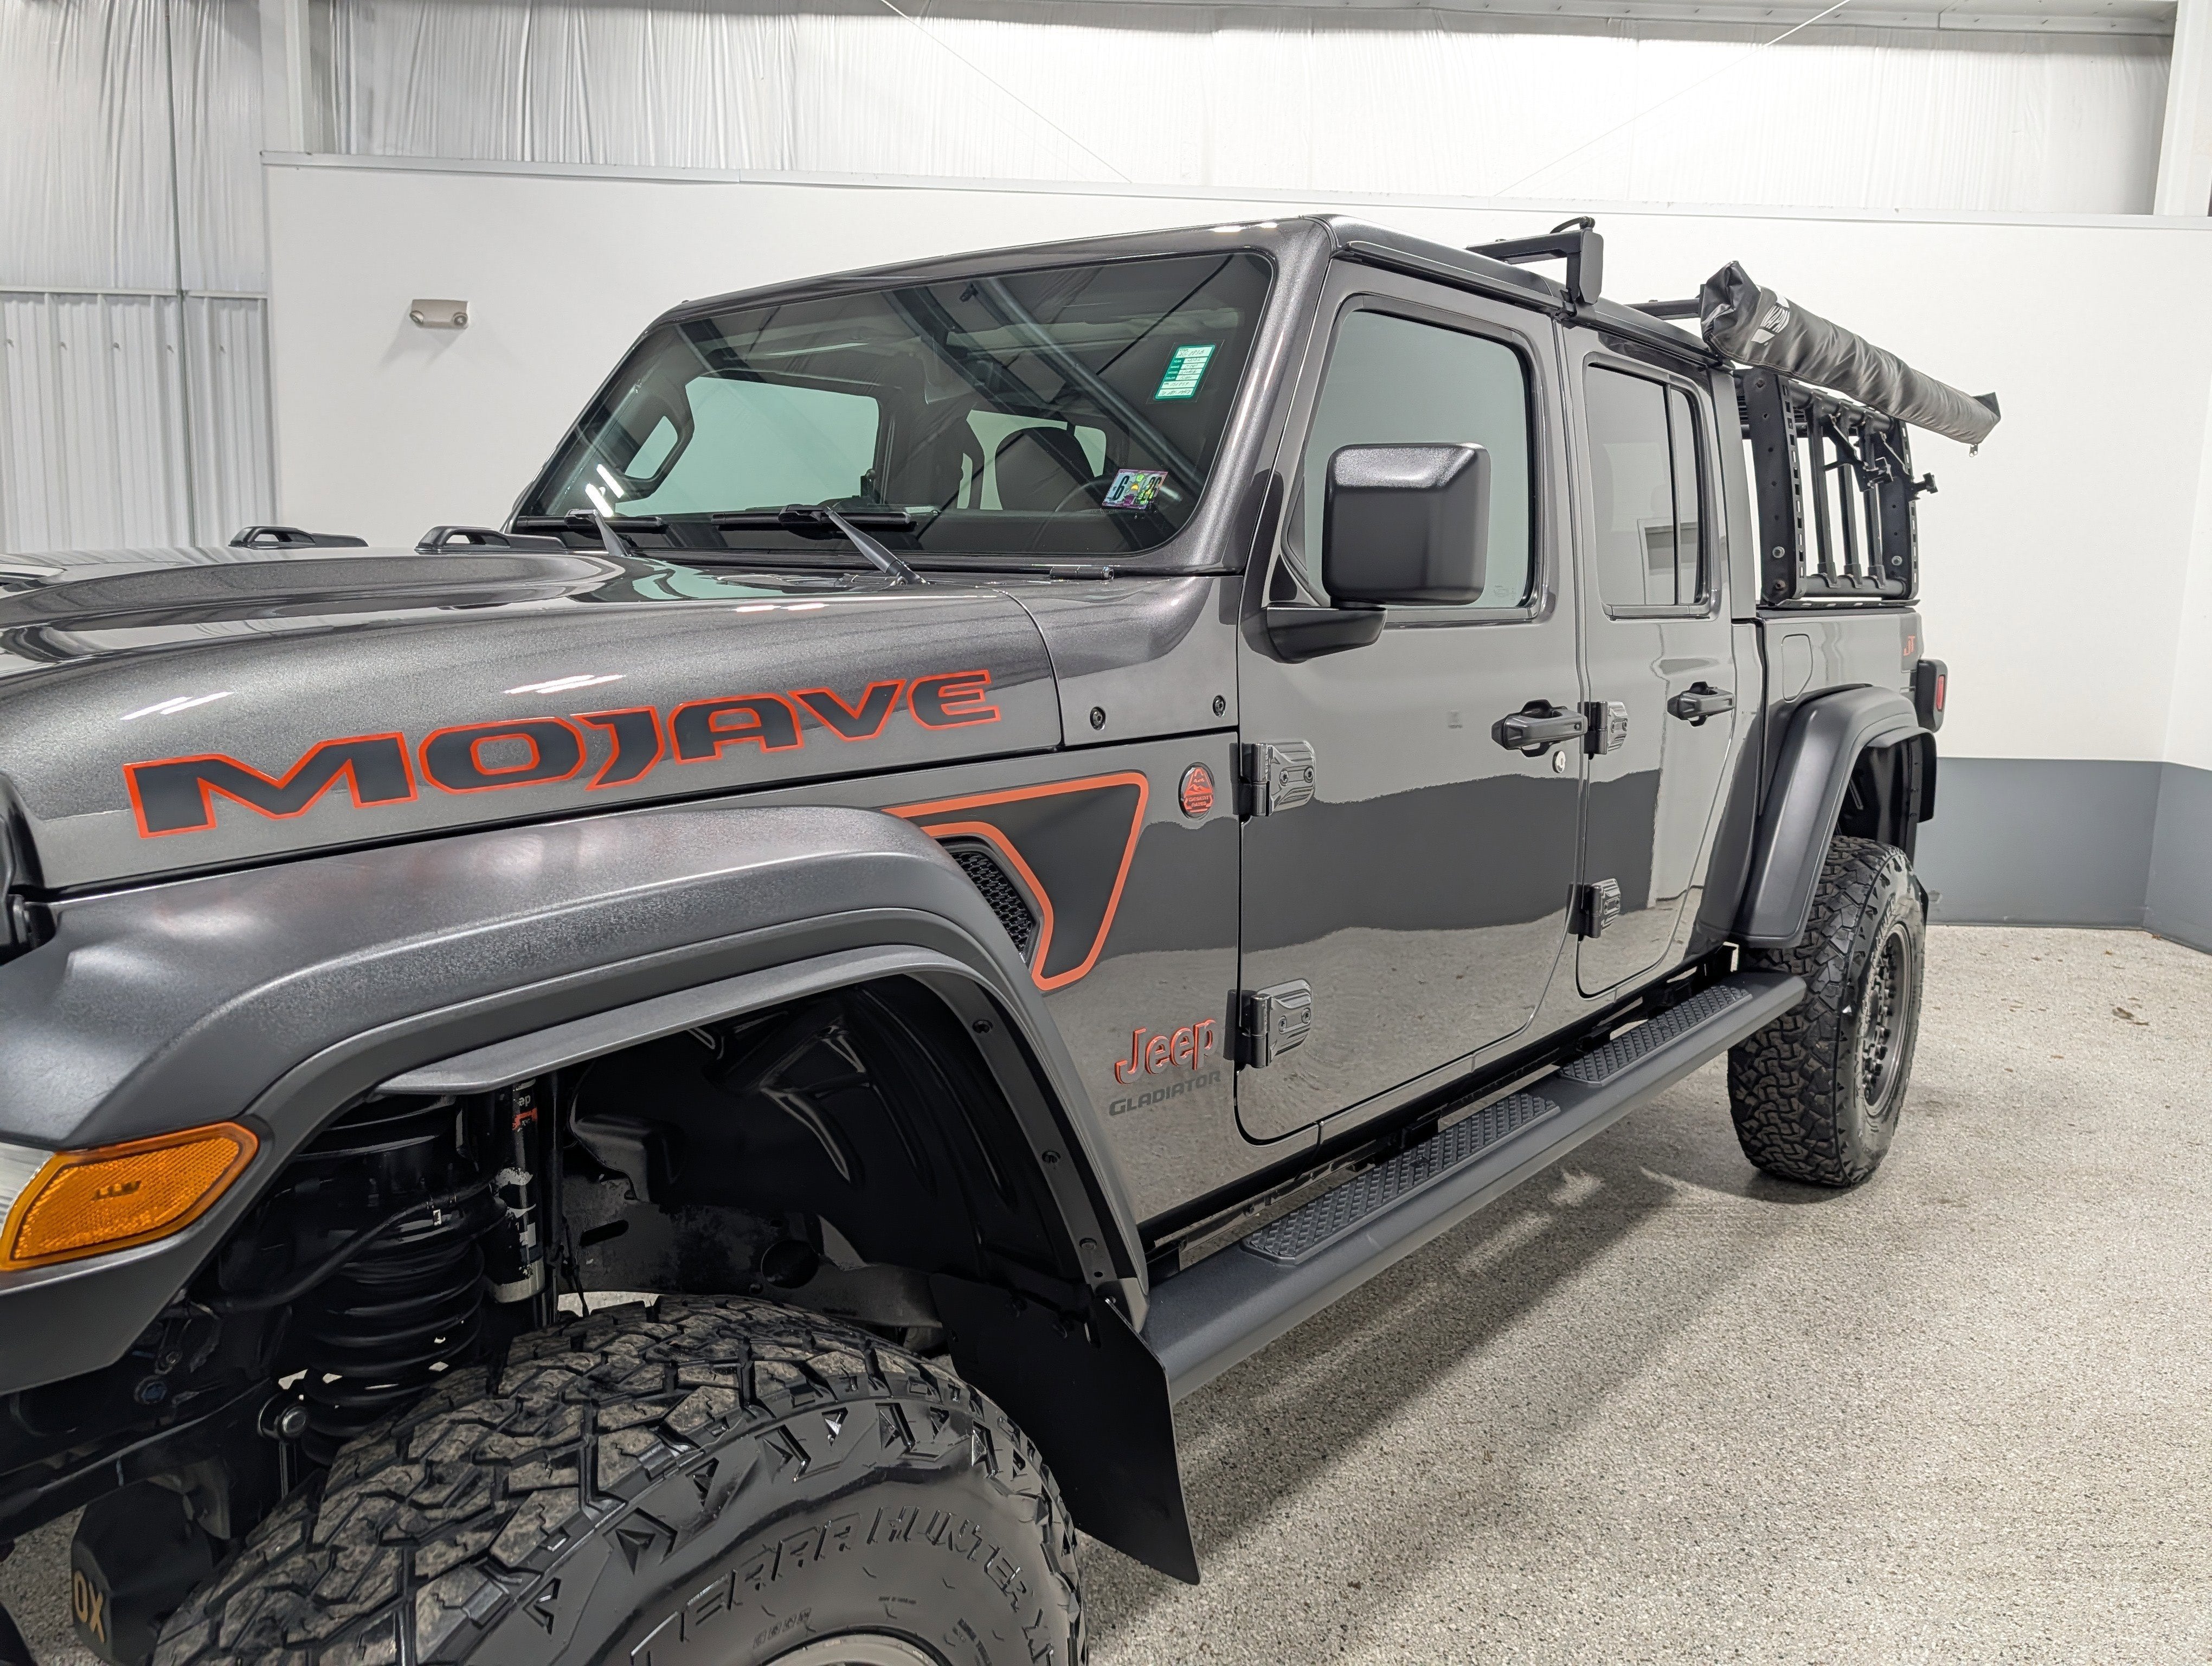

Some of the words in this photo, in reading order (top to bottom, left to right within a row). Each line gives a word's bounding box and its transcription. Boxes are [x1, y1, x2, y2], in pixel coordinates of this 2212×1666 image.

[124, 669, 1002, 838] MOJAVE
[1114, 1018, 1218, 1085] Jeep
[1109, 1070, 1221, 1117] GLADIATOR
